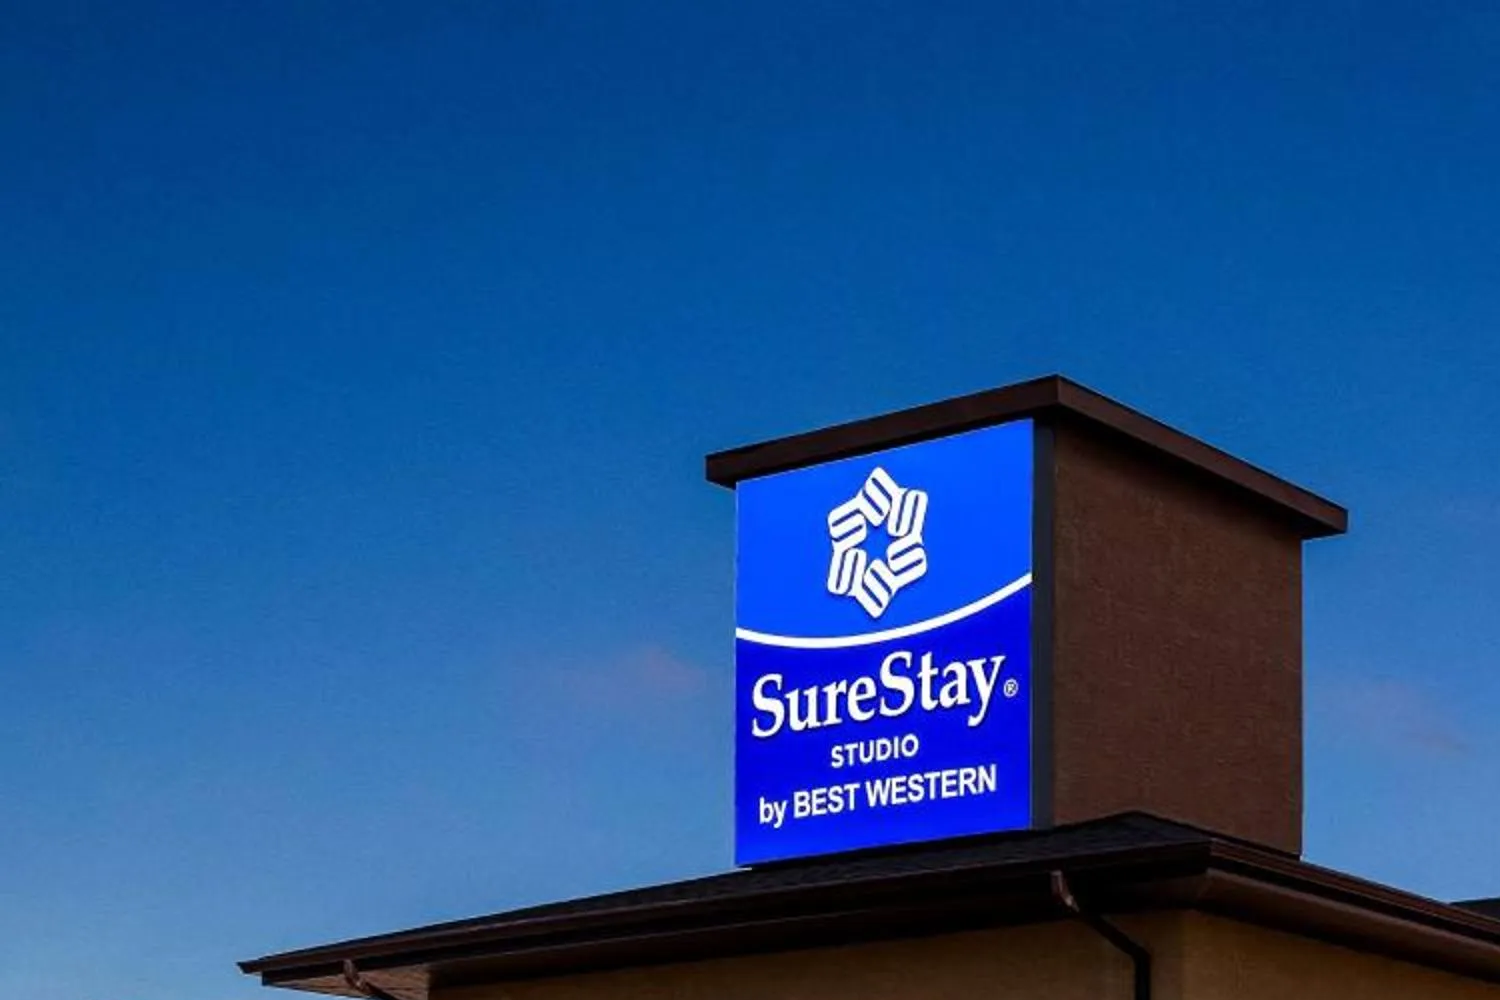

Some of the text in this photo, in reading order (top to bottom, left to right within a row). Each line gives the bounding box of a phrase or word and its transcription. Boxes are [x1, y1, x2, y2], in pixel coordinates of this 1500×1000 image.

[830, 733, 919, 769] STUDIO
[759, 763, 998, 829] by BEST WESTERN
